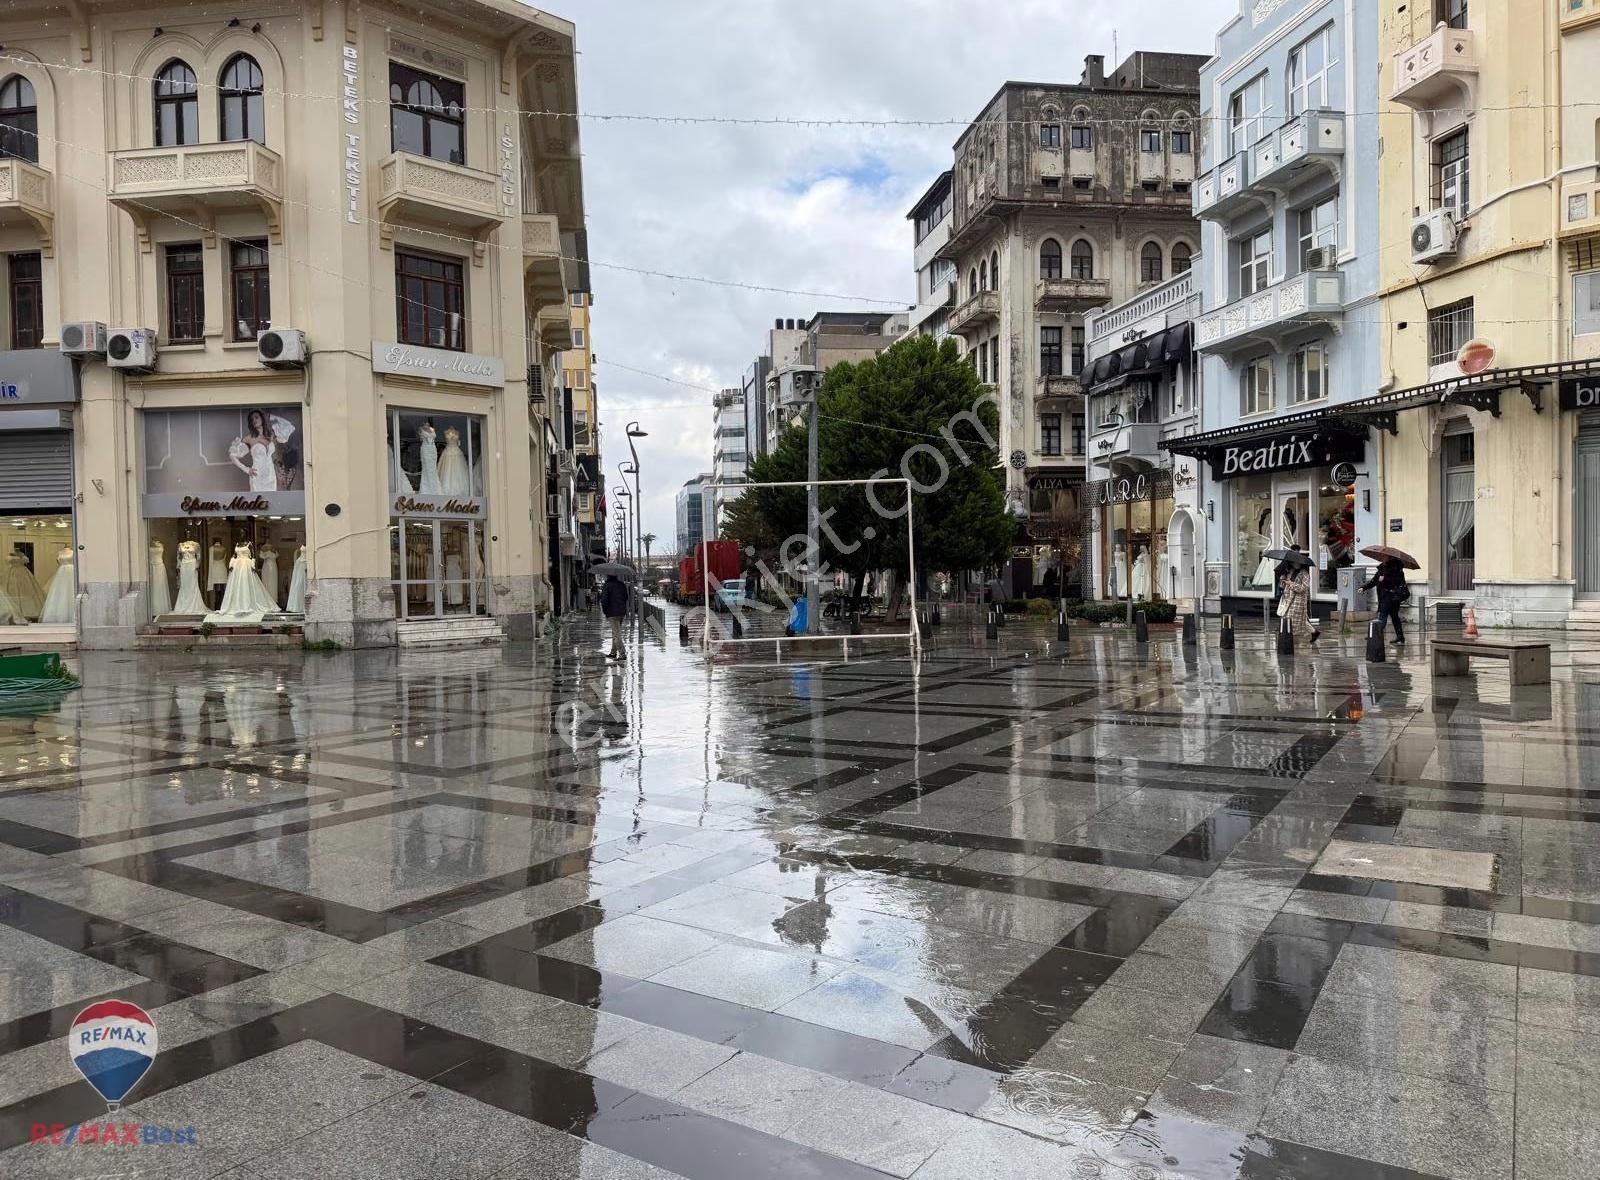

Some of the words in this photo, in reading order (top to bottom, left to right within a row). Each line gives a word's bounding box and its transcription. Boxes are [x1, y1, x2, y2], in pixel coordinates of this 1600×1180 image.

[343, 46, 359, 124] BETEKS
[346, 133, 361, 225] TEKSTİL
[384, 347, 437, 371] Efsun
[444, 355, 493, 377] Moda
[1223, 435, 1312, 474] Beatrix
[1034, 479, 1064, 489] ALYA
[181, 495, 220, 515] Efsun
[222, 495, 270, 512] Moda
[395, 495, 435, 514] Efsun
[437, 499, 481, 514] Moda
